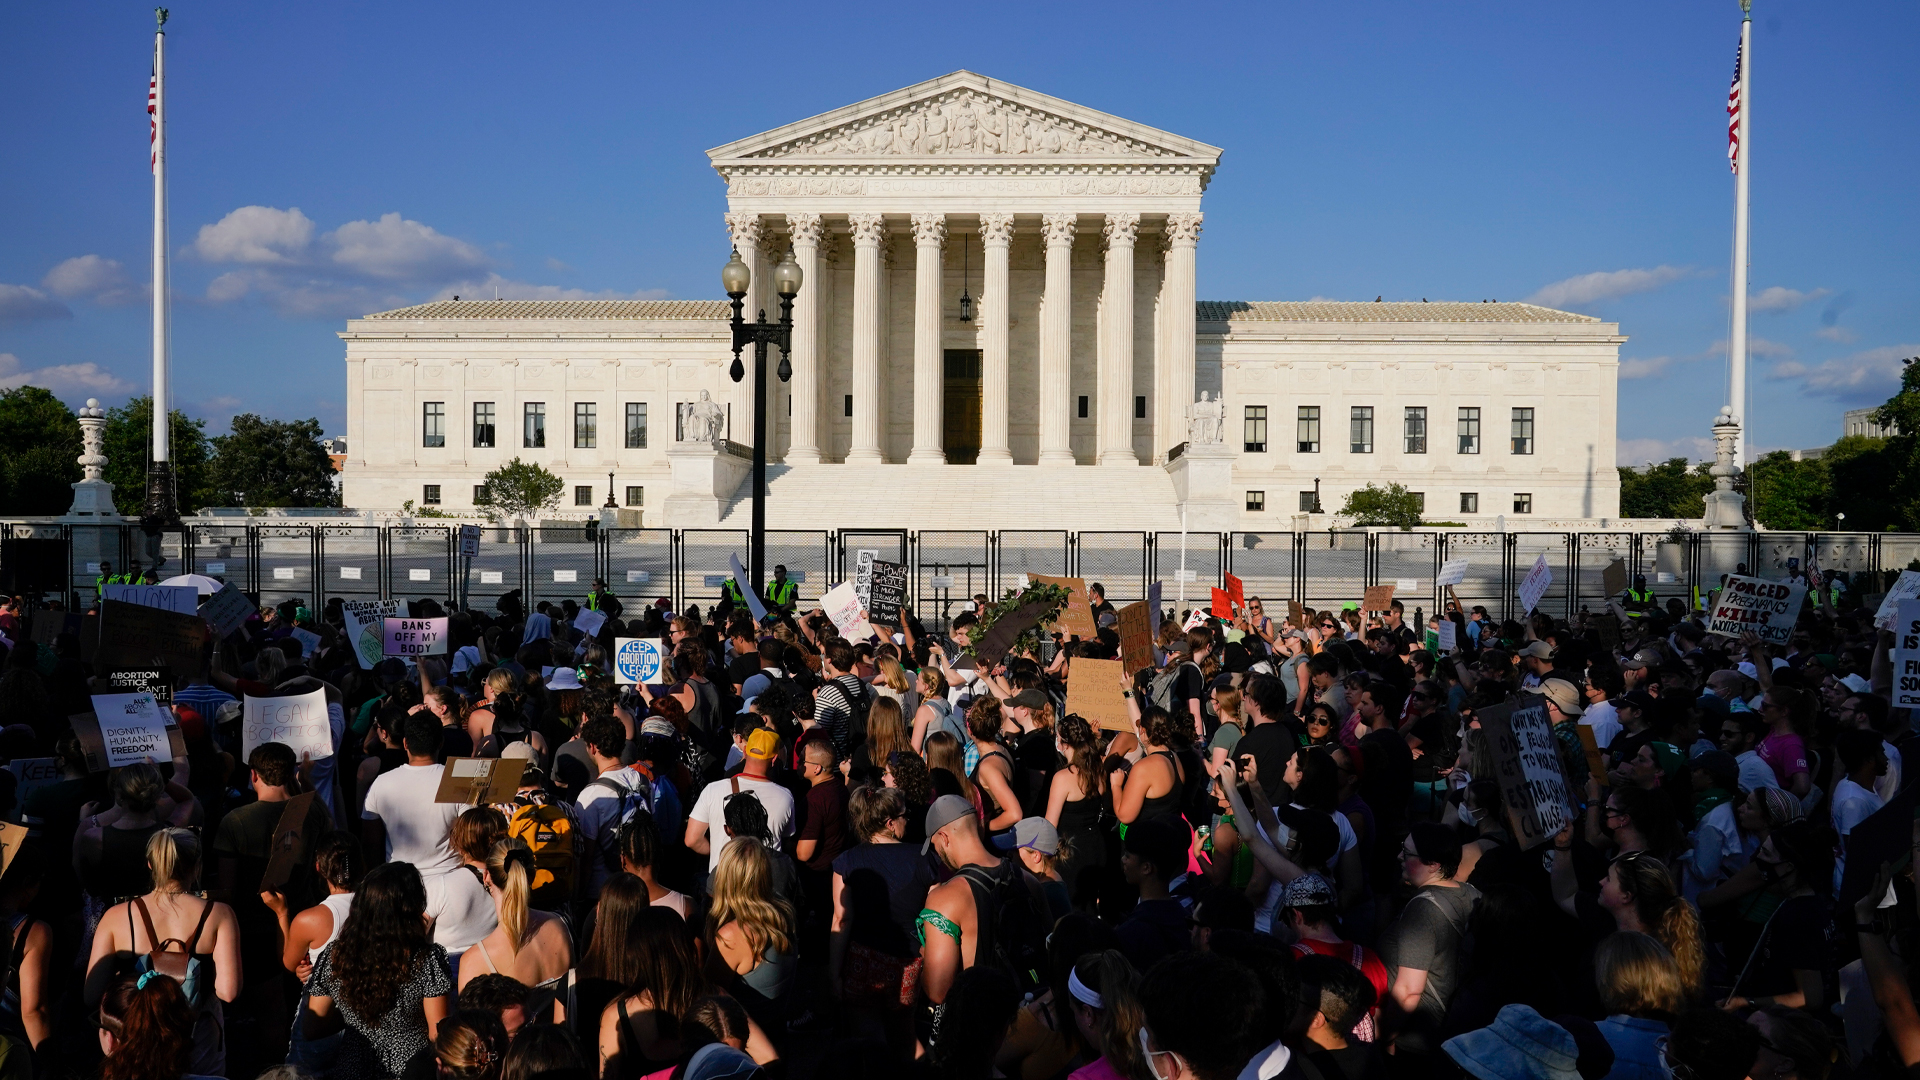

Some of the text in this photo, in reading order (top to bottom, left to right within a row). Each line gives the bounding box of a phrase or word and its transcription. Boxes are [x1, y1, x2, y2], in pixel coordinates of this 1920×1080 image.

[873, 181, 1052, 192] EQUAL JUSTICE UNDER LAW
[883, 563, 908, 577] POWER
[1727, 577, 1791, 600] FORCED
[344, 599, 401, 612] REASONS WHY
[1725, 592, 1790, 614] PREGNANCY
[352, 606, 397, 618] WOMEN HAVE
[1717, 606, 1773, 624] KILLS
[401, 621, 432, 630] BANS
[1711, 620, 1749, 635] WOMEN
[1758, 624, 1792, 642] GIRLS!
[394, 632, 438, 642] OFF MY
[400, 643, 432, 653] BODY
[625, 641, 652, 653] KEEP
[619, 652, 659, 665] ABORTION
[110, 671, 159, 679] ABORTION
[622, 664, 655, 678] LEGAL
[110, 679, 148, 687] JUSTICE
[137, 685, 167, 693] CAN'T
[1077, 683, 1121, 694] CONTRACEP
[1095, 697, 1128, 707] CHILDCAR
[252, 703, 321, 724] LEGAL
[1512, 712, 1528, 731] WHY
[106, 726, 150, 737] DIGNITY.
[109, 734, 162, 746] HUMANITY.
[111, 744, 158, 755] FREEDOM.
[1501, 756, 1521, 777] GET
[1522, 753, 1536, 768] TO
